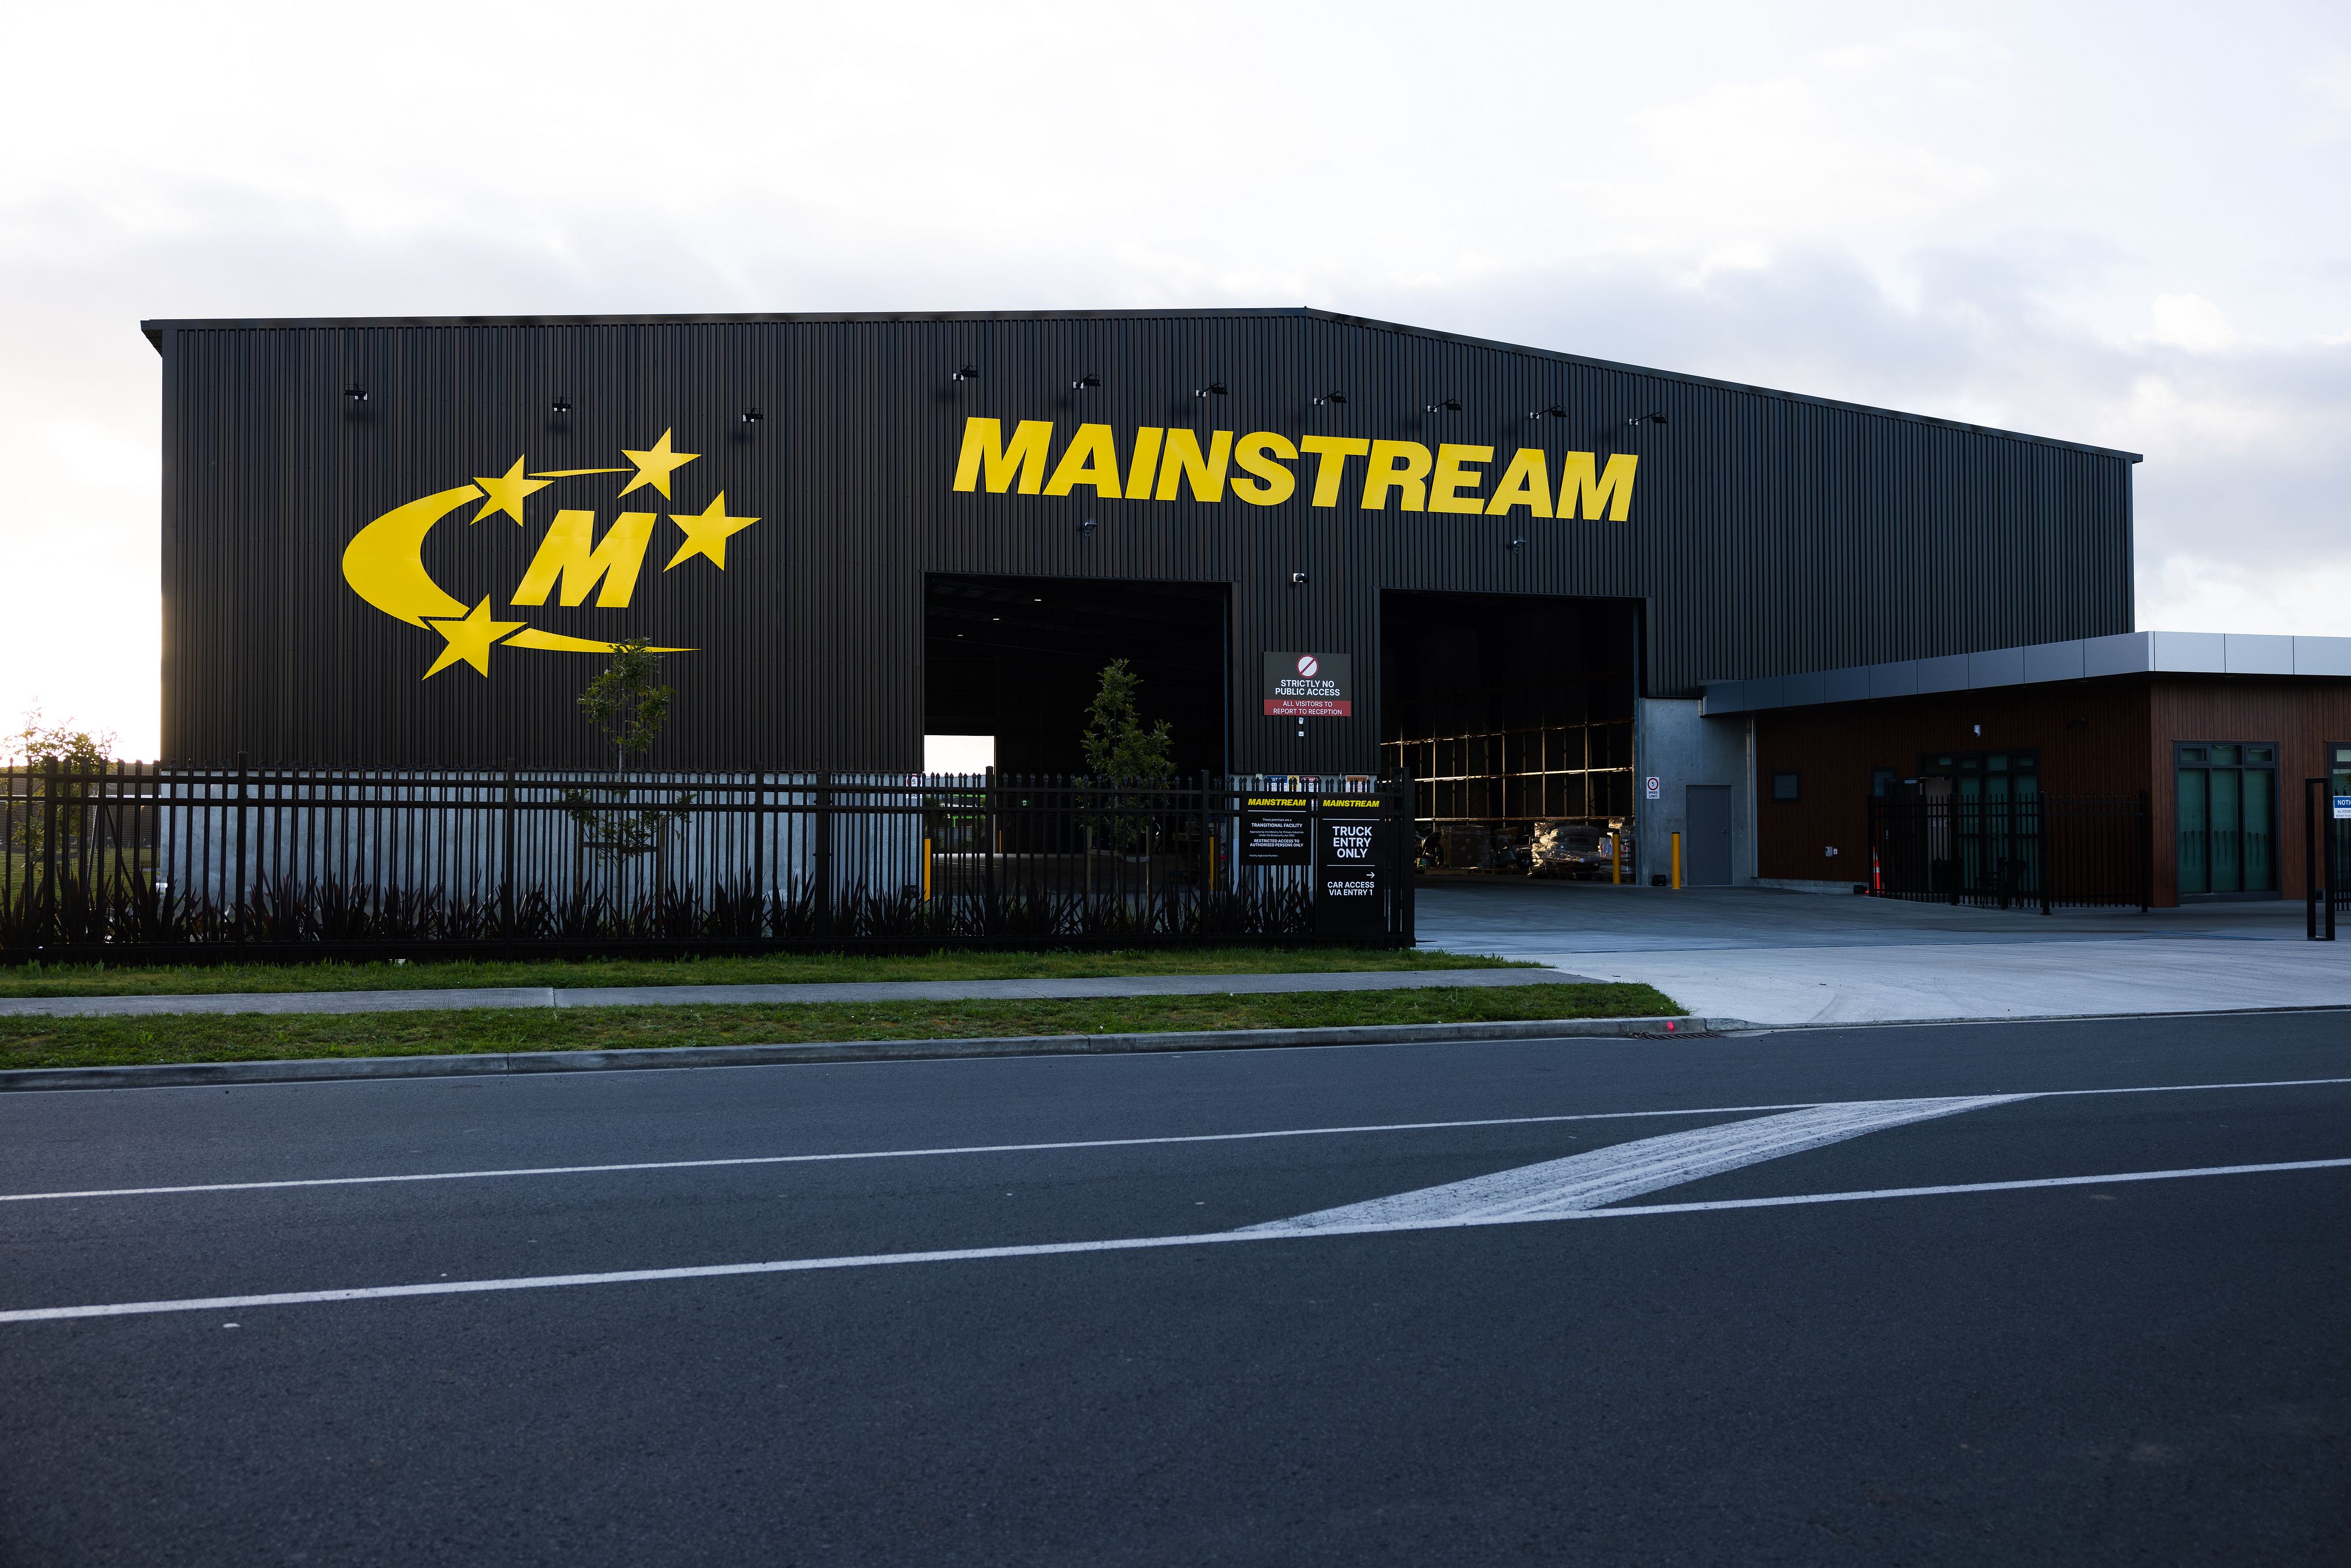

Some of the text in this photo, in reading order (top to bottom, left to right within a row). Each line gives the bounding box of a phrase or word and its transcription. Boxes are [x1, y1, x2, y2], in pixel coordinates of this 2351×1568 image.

[953, 417, 1638, 521] MAINSTREAM
[510, 510, 657, 608] M
[1281, 679, 1320, 687] STRICTLY
[1332, 826, 1372, 836] TRUCK
[1333, 837, 1371, 847] ENTRY
[1337, 848, 1367, 858] ONLY
